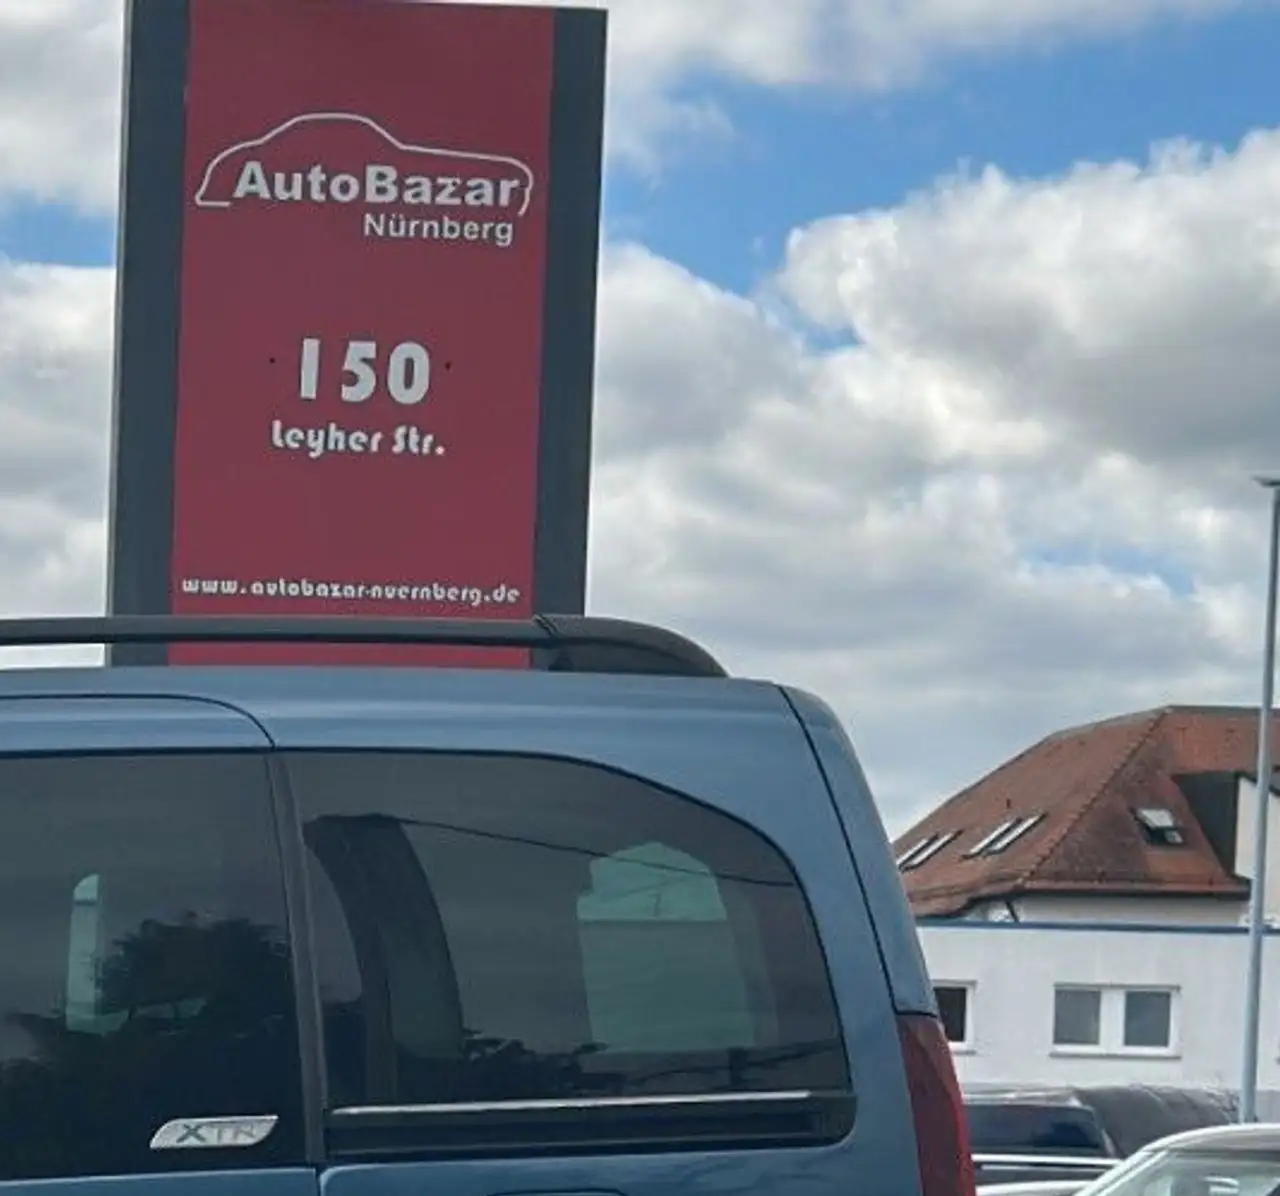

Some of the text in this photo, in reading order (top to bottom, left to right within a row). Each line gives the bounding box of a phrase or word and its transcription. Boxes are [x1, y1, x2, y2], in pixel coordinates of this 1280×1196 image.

[232, 160, 520, 206] AutoBazar
[362, 212, 513, 247] Nürnberg
[300, 337, 430, 405] 150
[271, 419, 446, 459] Leyher Str.
[182, 577, 522, 607] www.autobazar-nuernberg.de
